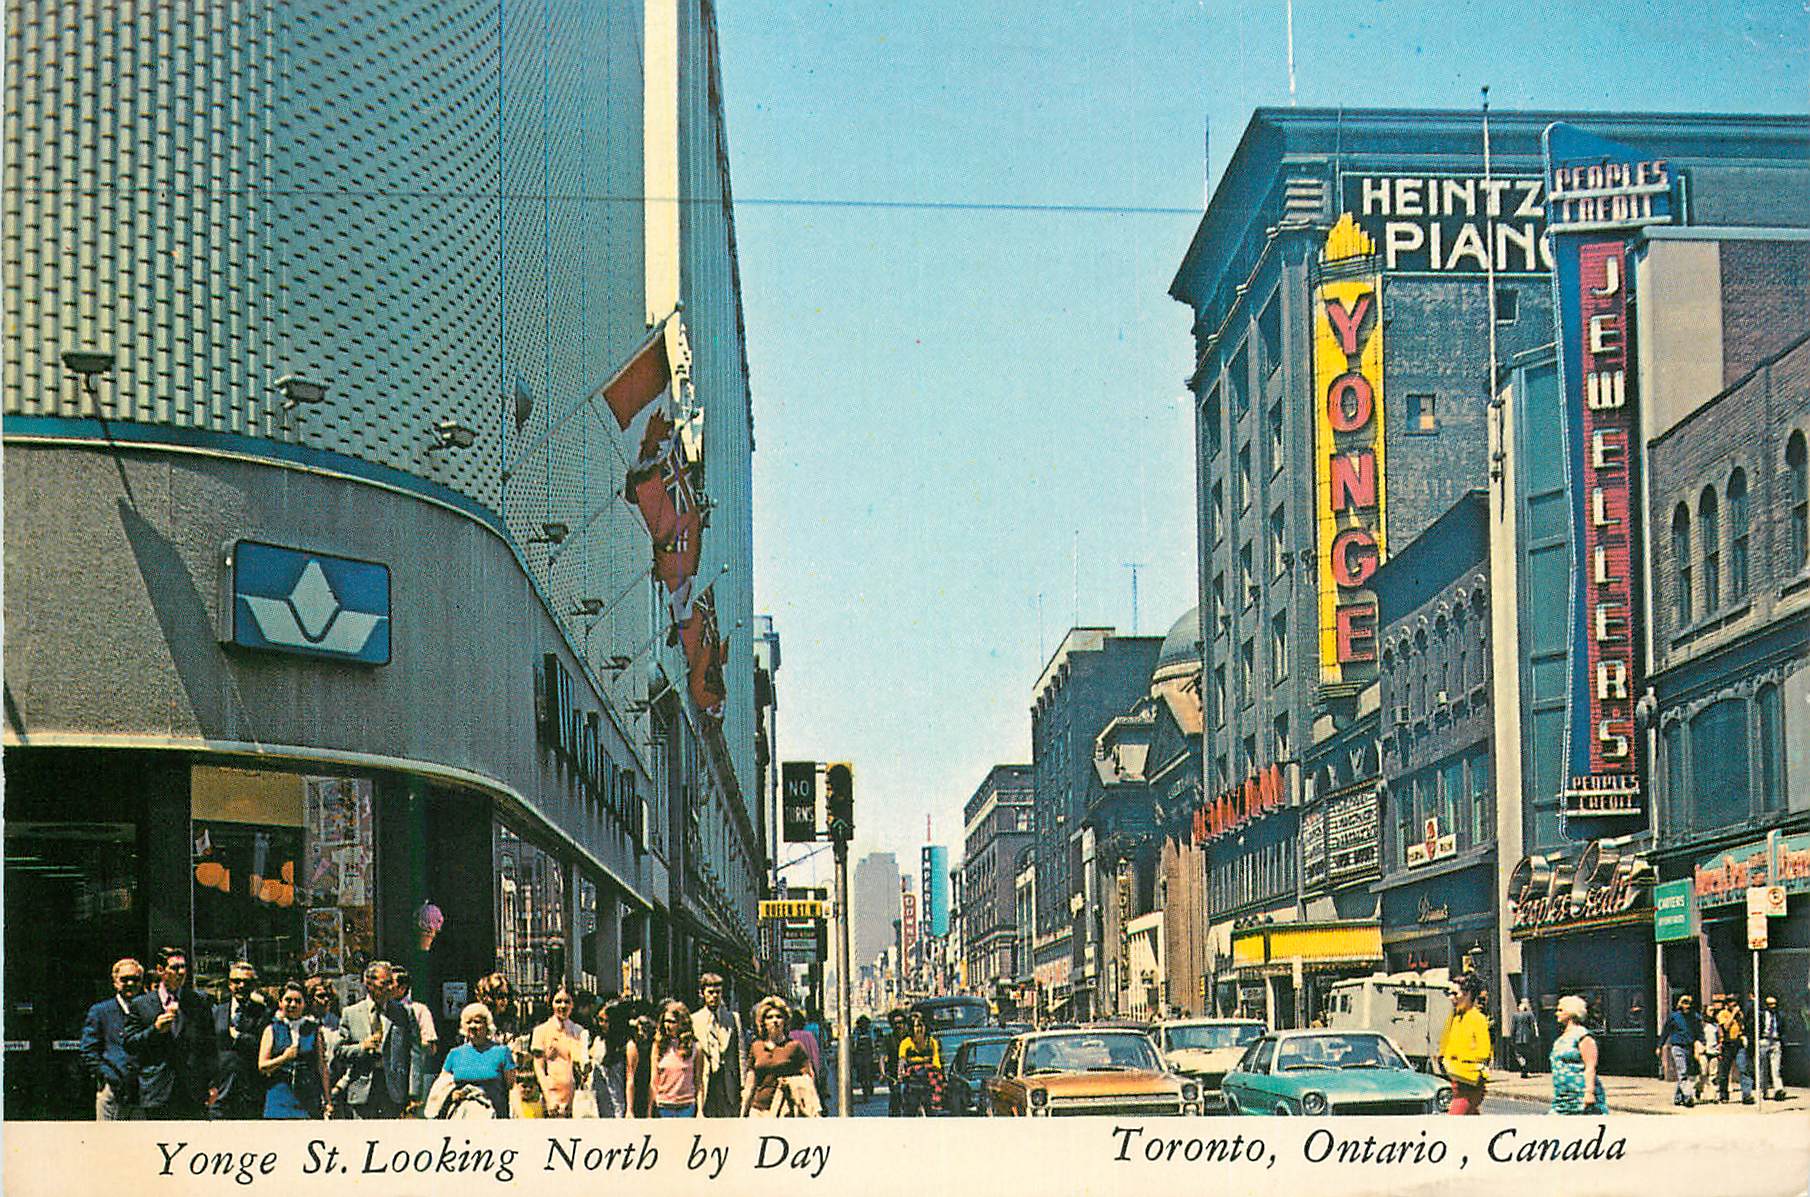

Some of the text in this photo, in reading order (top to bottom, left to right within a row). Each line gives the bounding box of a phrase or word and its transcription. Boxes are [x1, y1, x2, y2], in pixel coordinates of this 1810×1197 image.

[1555, 161, 1668, 193] PEOPLES
[1562, 194, 1652, 222] CREDIT
[1325, 293, 1379, 662] YONGE
[1588, 255, 1629, 760] JEWELLERS
[789, 780, 810, 798] NO
[1572, 775, 1640, 791] PEOPLES
[1579, 794, 1633, 810] CREDIT
[785, 805, 814, 823] TURNS
[923, 848, 932, 933] IMPERIAL
[765, 903, 793, 916] QUEEN
